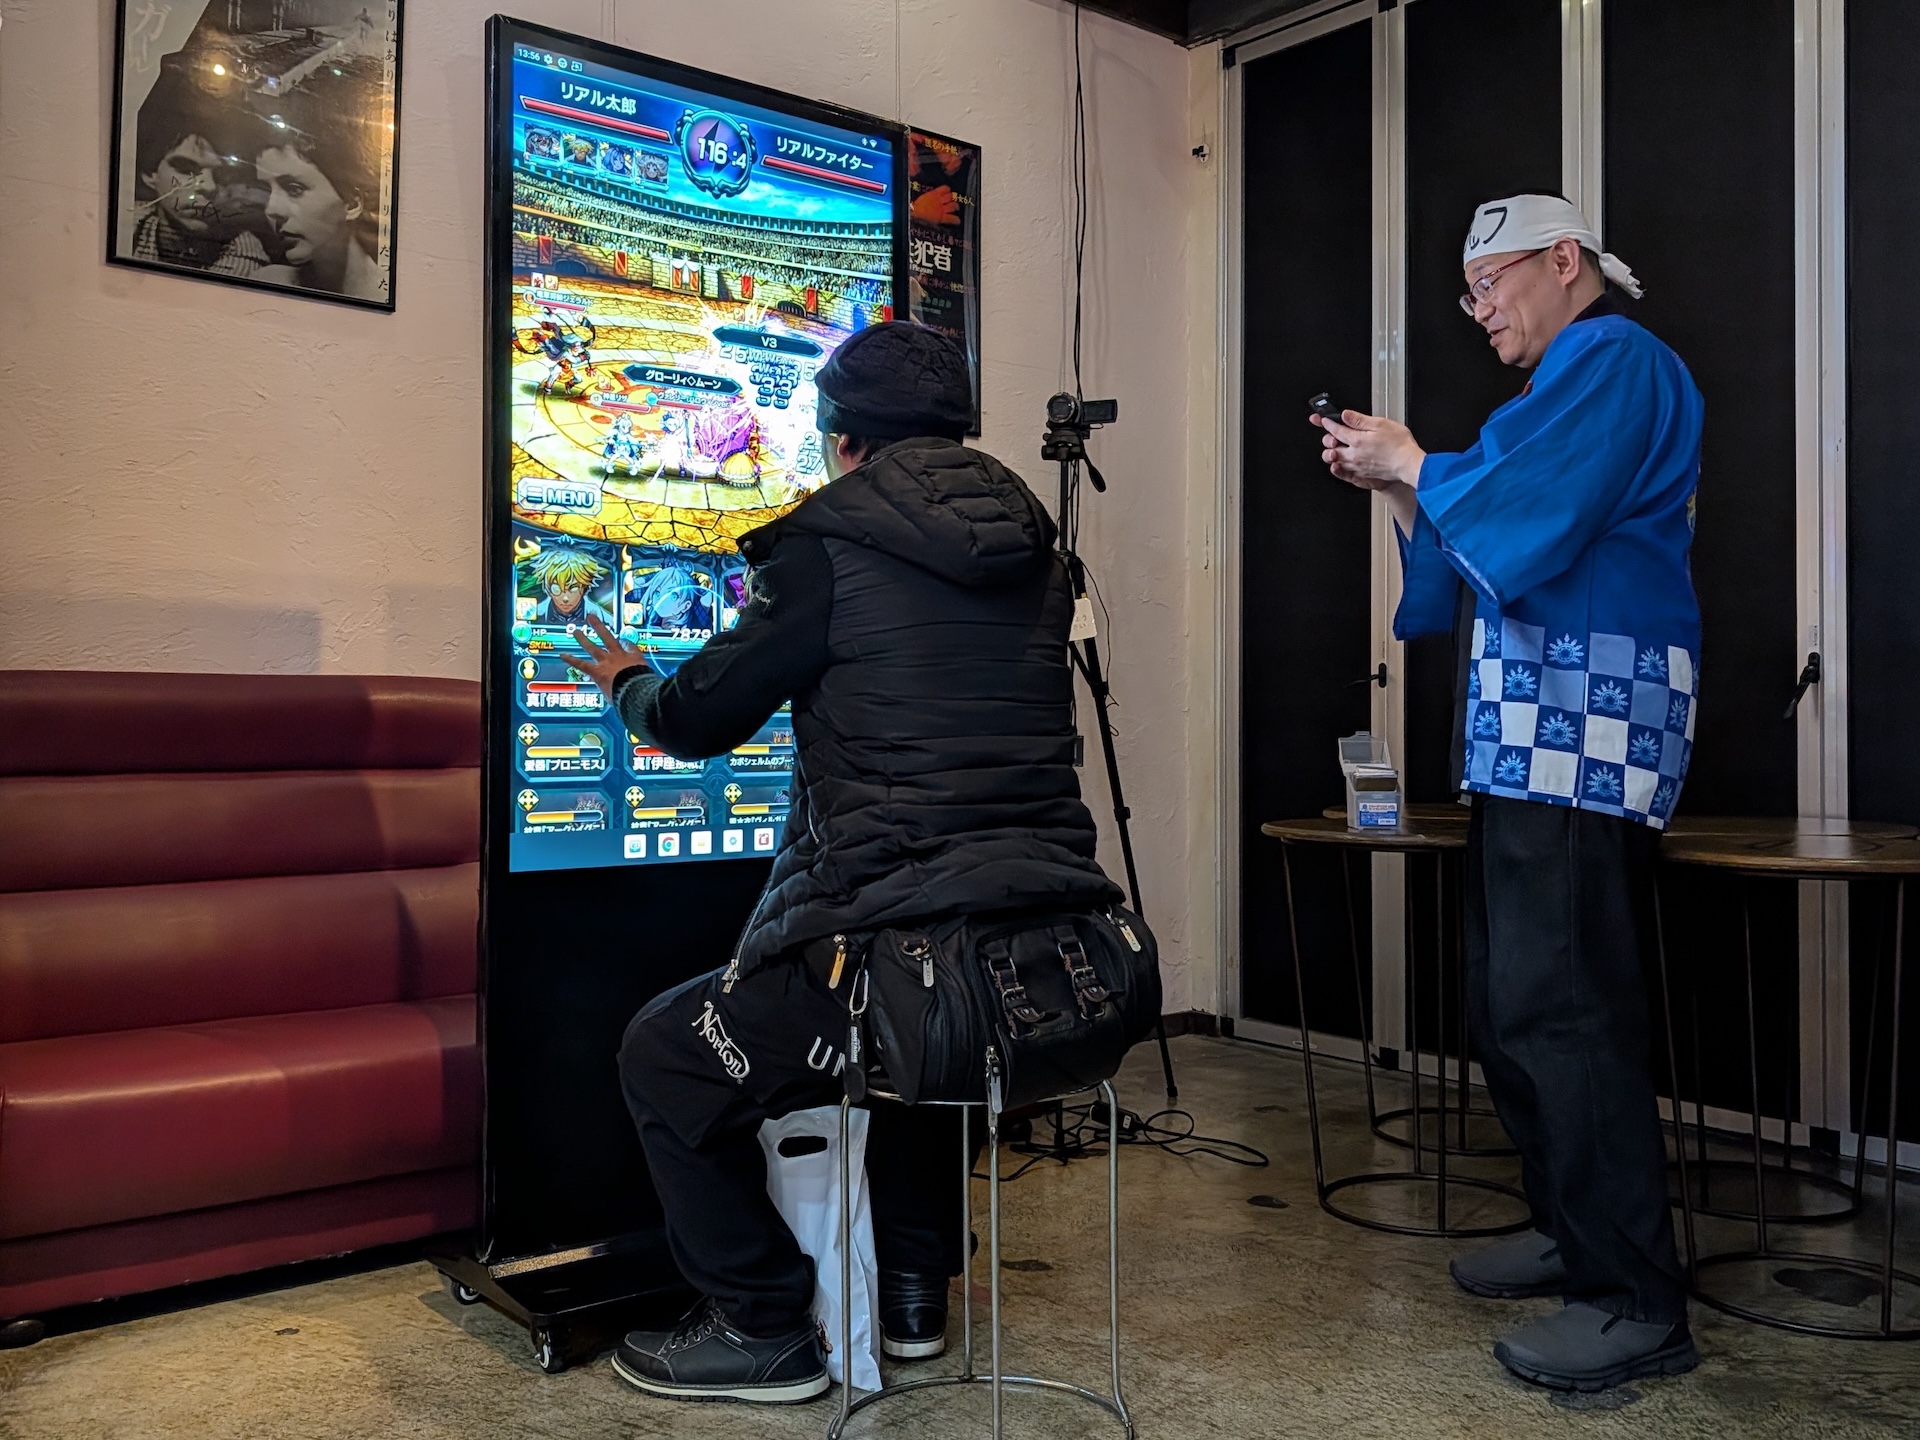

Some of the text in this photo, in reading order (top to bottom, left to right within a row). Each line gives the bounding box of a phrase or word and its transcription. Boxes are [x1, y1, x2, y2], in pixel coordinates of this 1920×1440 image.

[518, 49, 541, 61] 13:56
[561, 82, 637, 115] リアル太郎
[776, 136, 874, 171] リアルファイター
[761, 336, 778, 348] V3
[547, 488, 595, 508] MENU
[532, 629, 547, 637] HP
[640, 632, 653, 640] HP
[670, 628, 712, 643] 7879
[529, 641, 554, 650] SKILL
[691, 1001, 750, 1080] Norton
